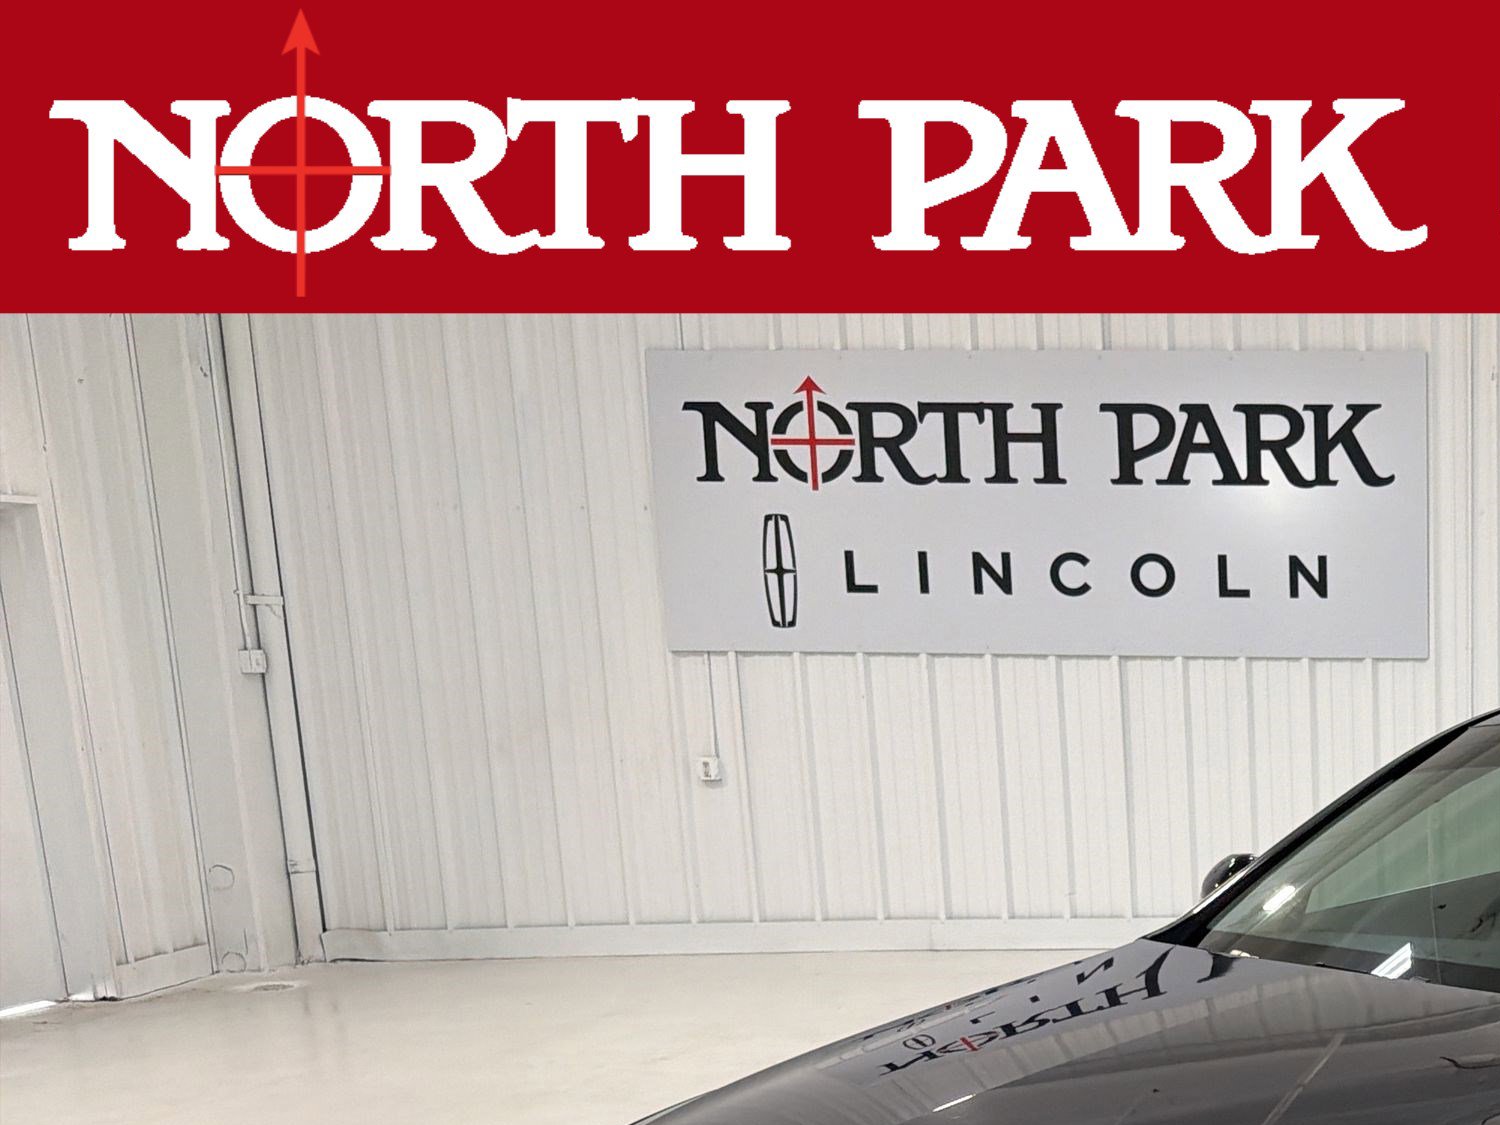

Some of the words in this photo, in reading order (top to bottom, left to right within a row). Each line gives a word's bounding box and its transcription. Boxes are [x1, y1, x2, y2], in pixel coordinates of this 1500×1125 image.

[682, 400, 1066, 488] NORTH
[1100, 402, 1395, 489] PARK
[845, 550, 1329, 600] LINCOLN
